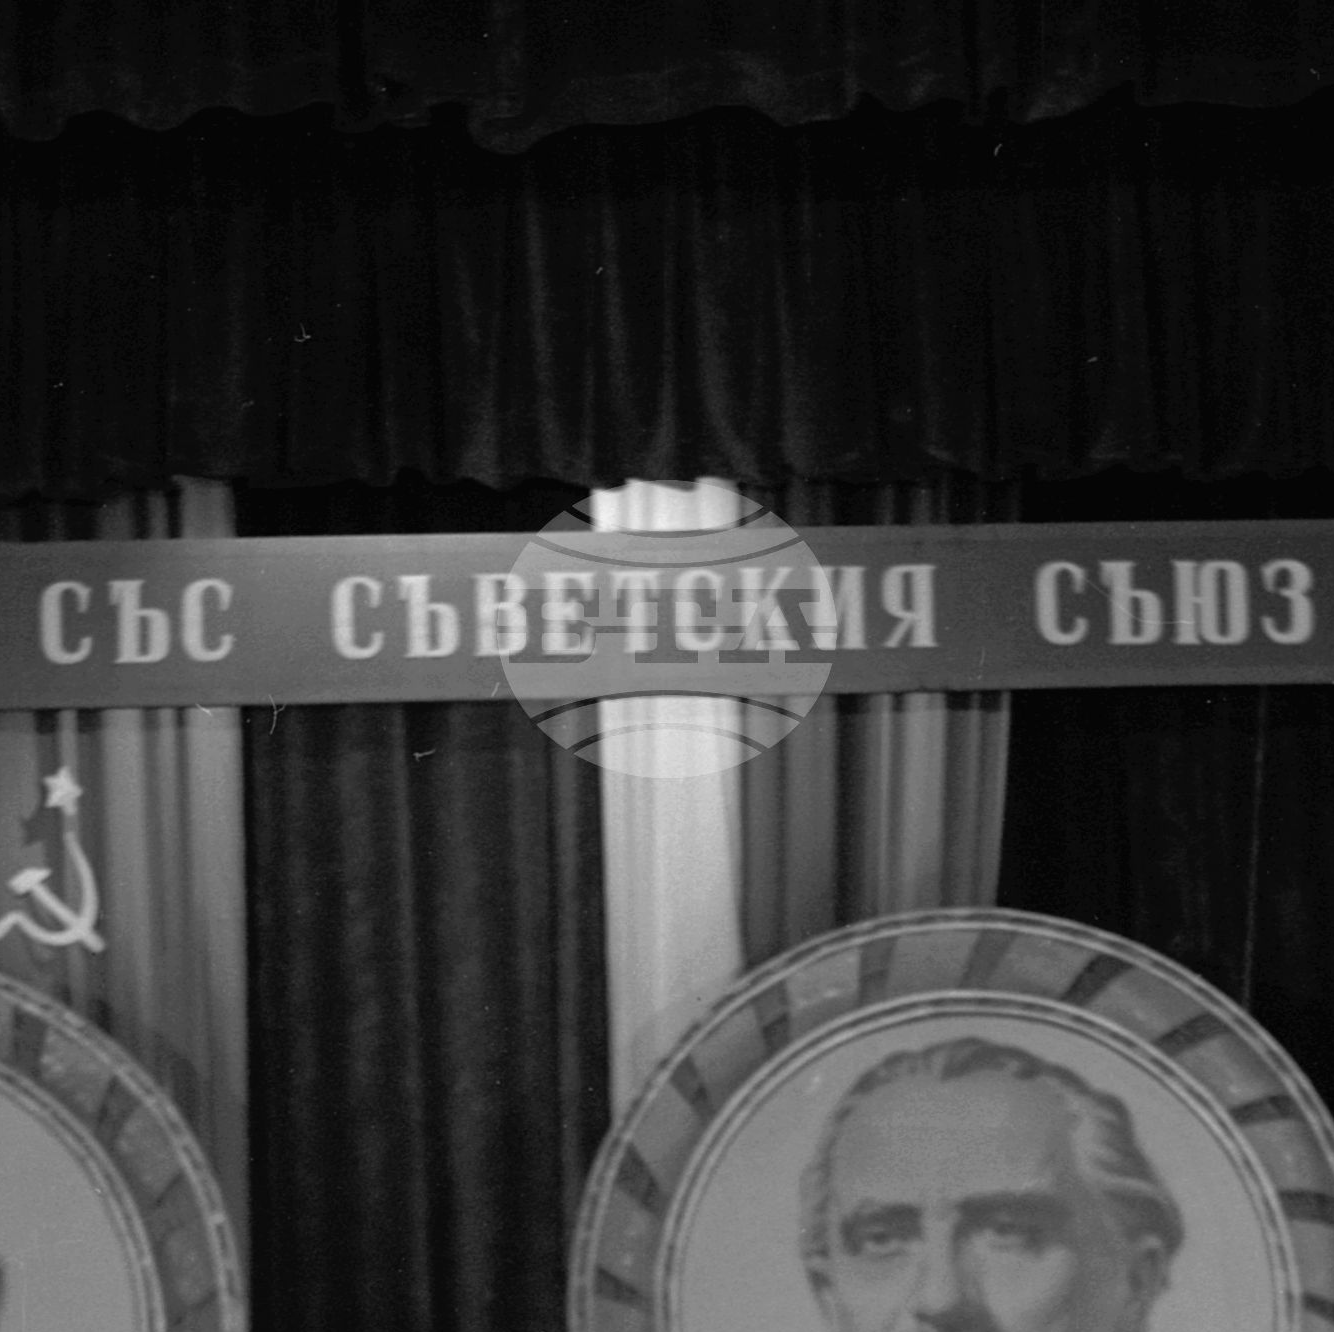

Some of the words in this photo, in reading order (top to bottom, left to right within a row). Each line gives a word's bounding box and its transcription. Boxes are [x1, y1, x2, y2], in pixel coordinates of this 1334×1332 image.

[38, 577, 235, 666] СЪС
[329, 562, 940, 660] СЪВЕТСКИЯ
[1034, 558, 1316, 647] СЪЮЗ
